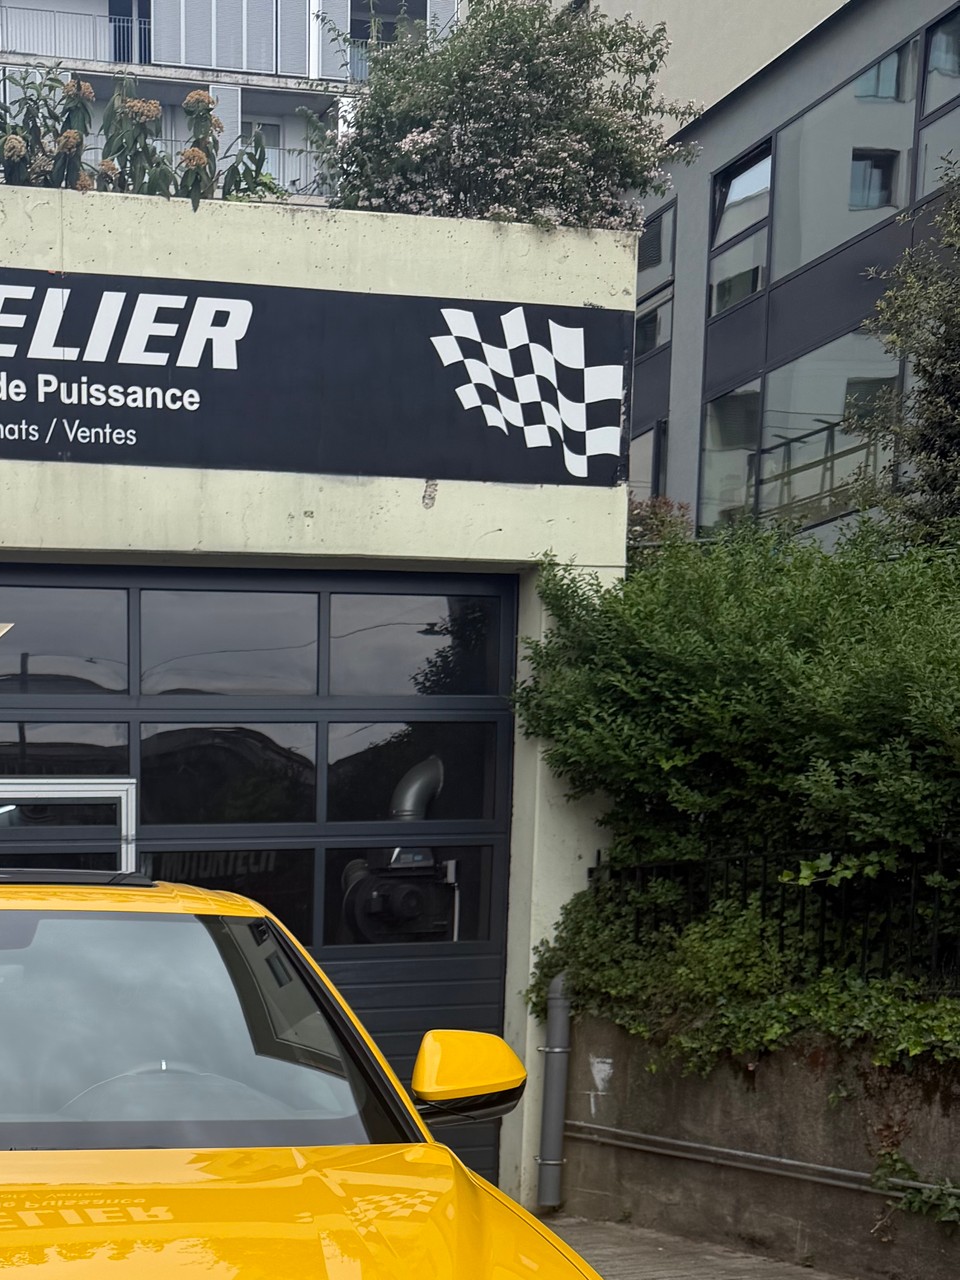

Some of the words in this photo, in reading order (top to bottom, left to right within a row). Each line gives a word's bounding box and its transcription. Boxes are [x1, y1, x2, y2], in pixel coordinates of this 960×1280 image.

[37, 373, 201, 411] Puissance
[44, 417, 58, 444] /
[62, 418, 137, 445] Ventes
